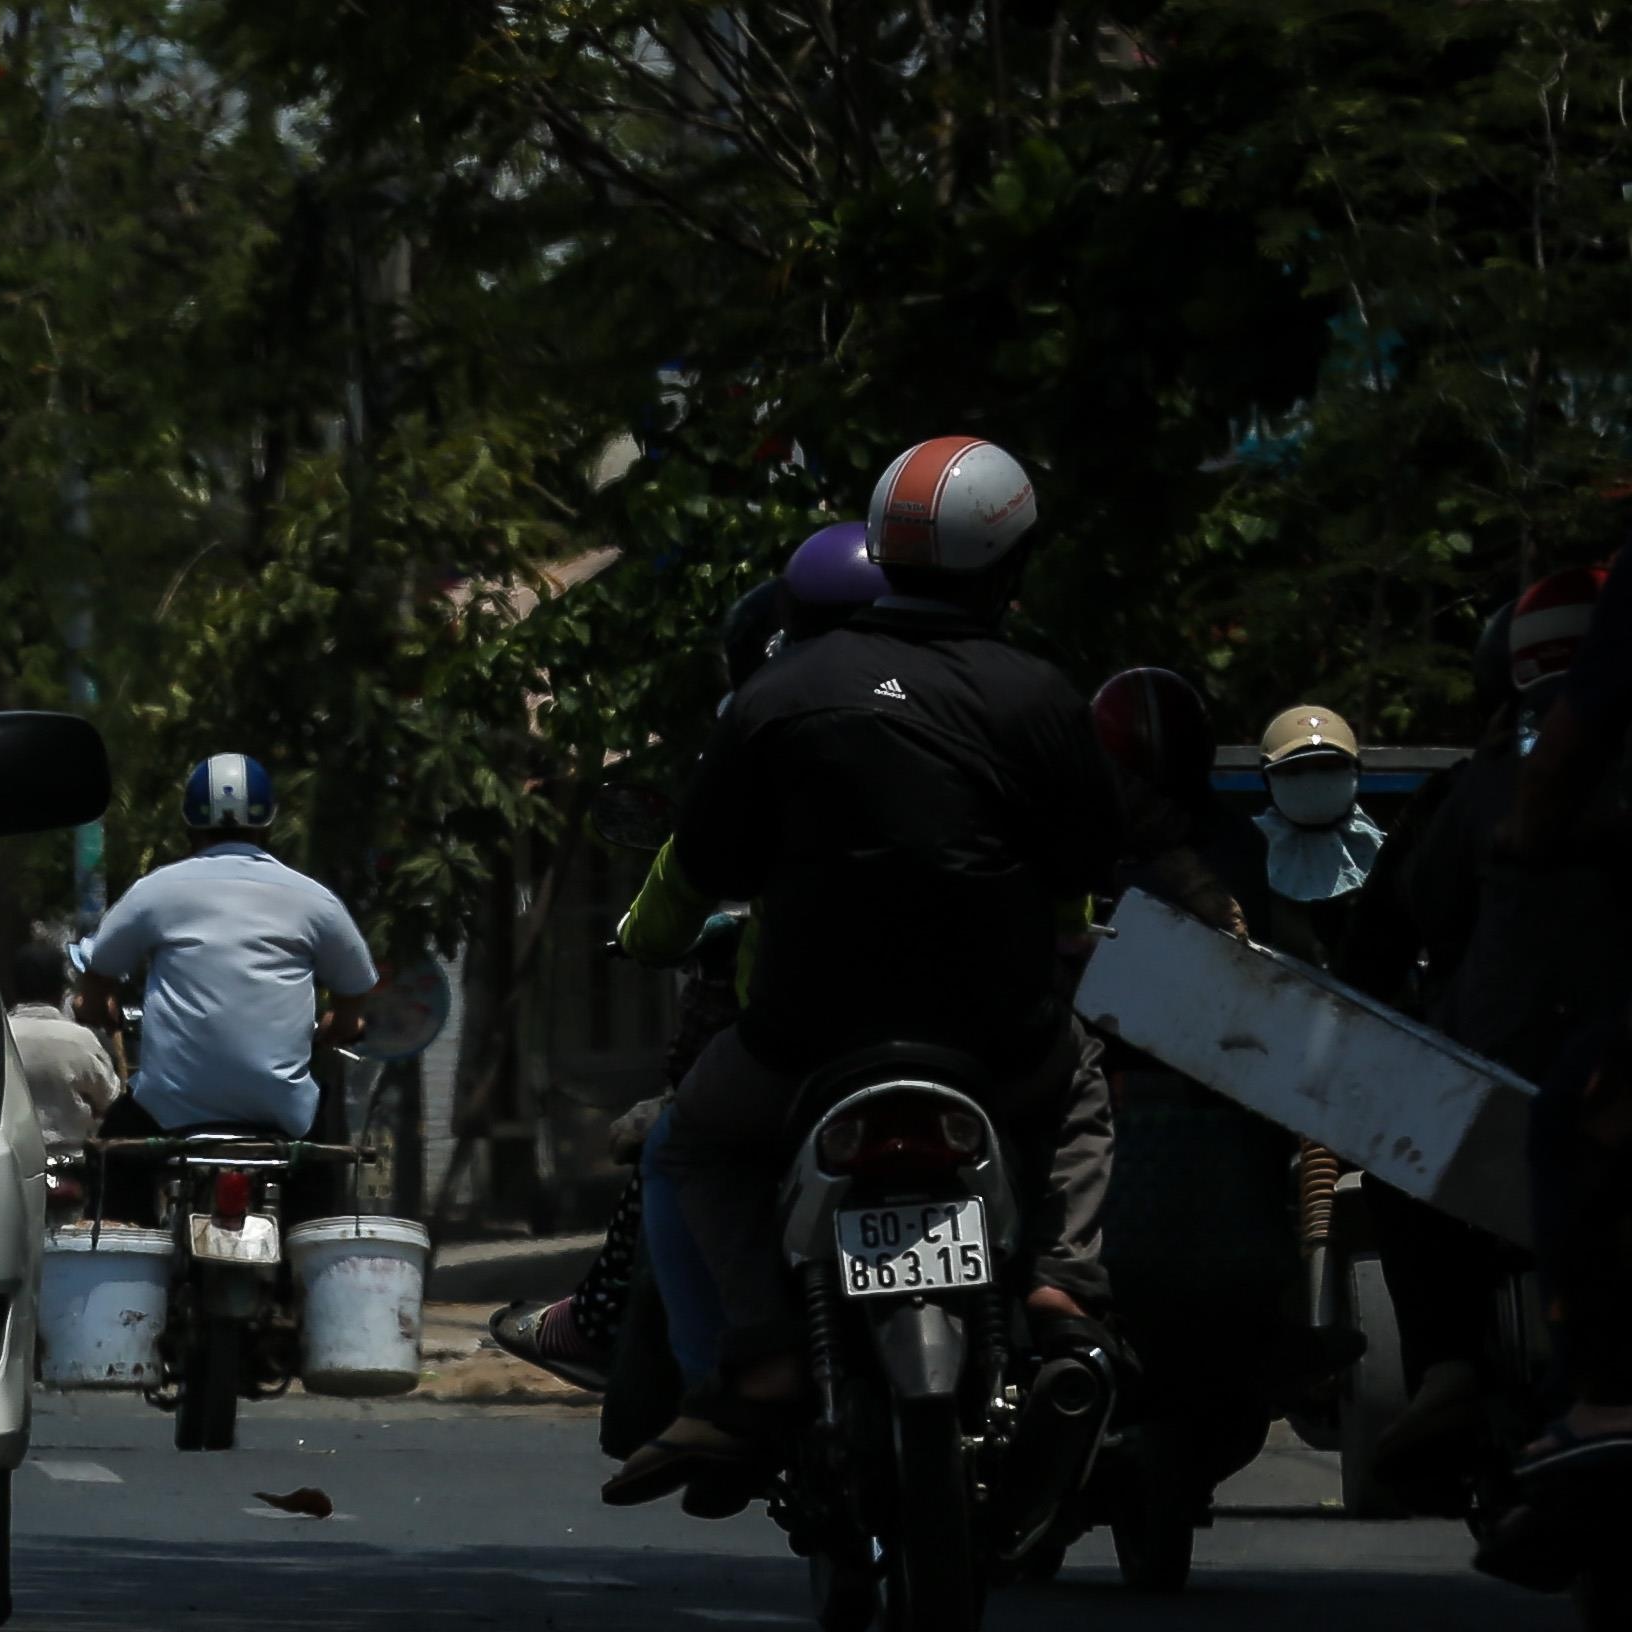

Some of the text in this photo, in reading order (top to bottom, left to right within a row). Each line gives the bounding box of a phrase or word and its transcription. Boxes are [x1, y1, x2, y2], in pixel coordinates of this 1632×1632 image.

[874, 688, 906, 700] adidas
[860, 1204, 961, 1248] 60-C1
[850, 1244, 983, 1290] 863.15
